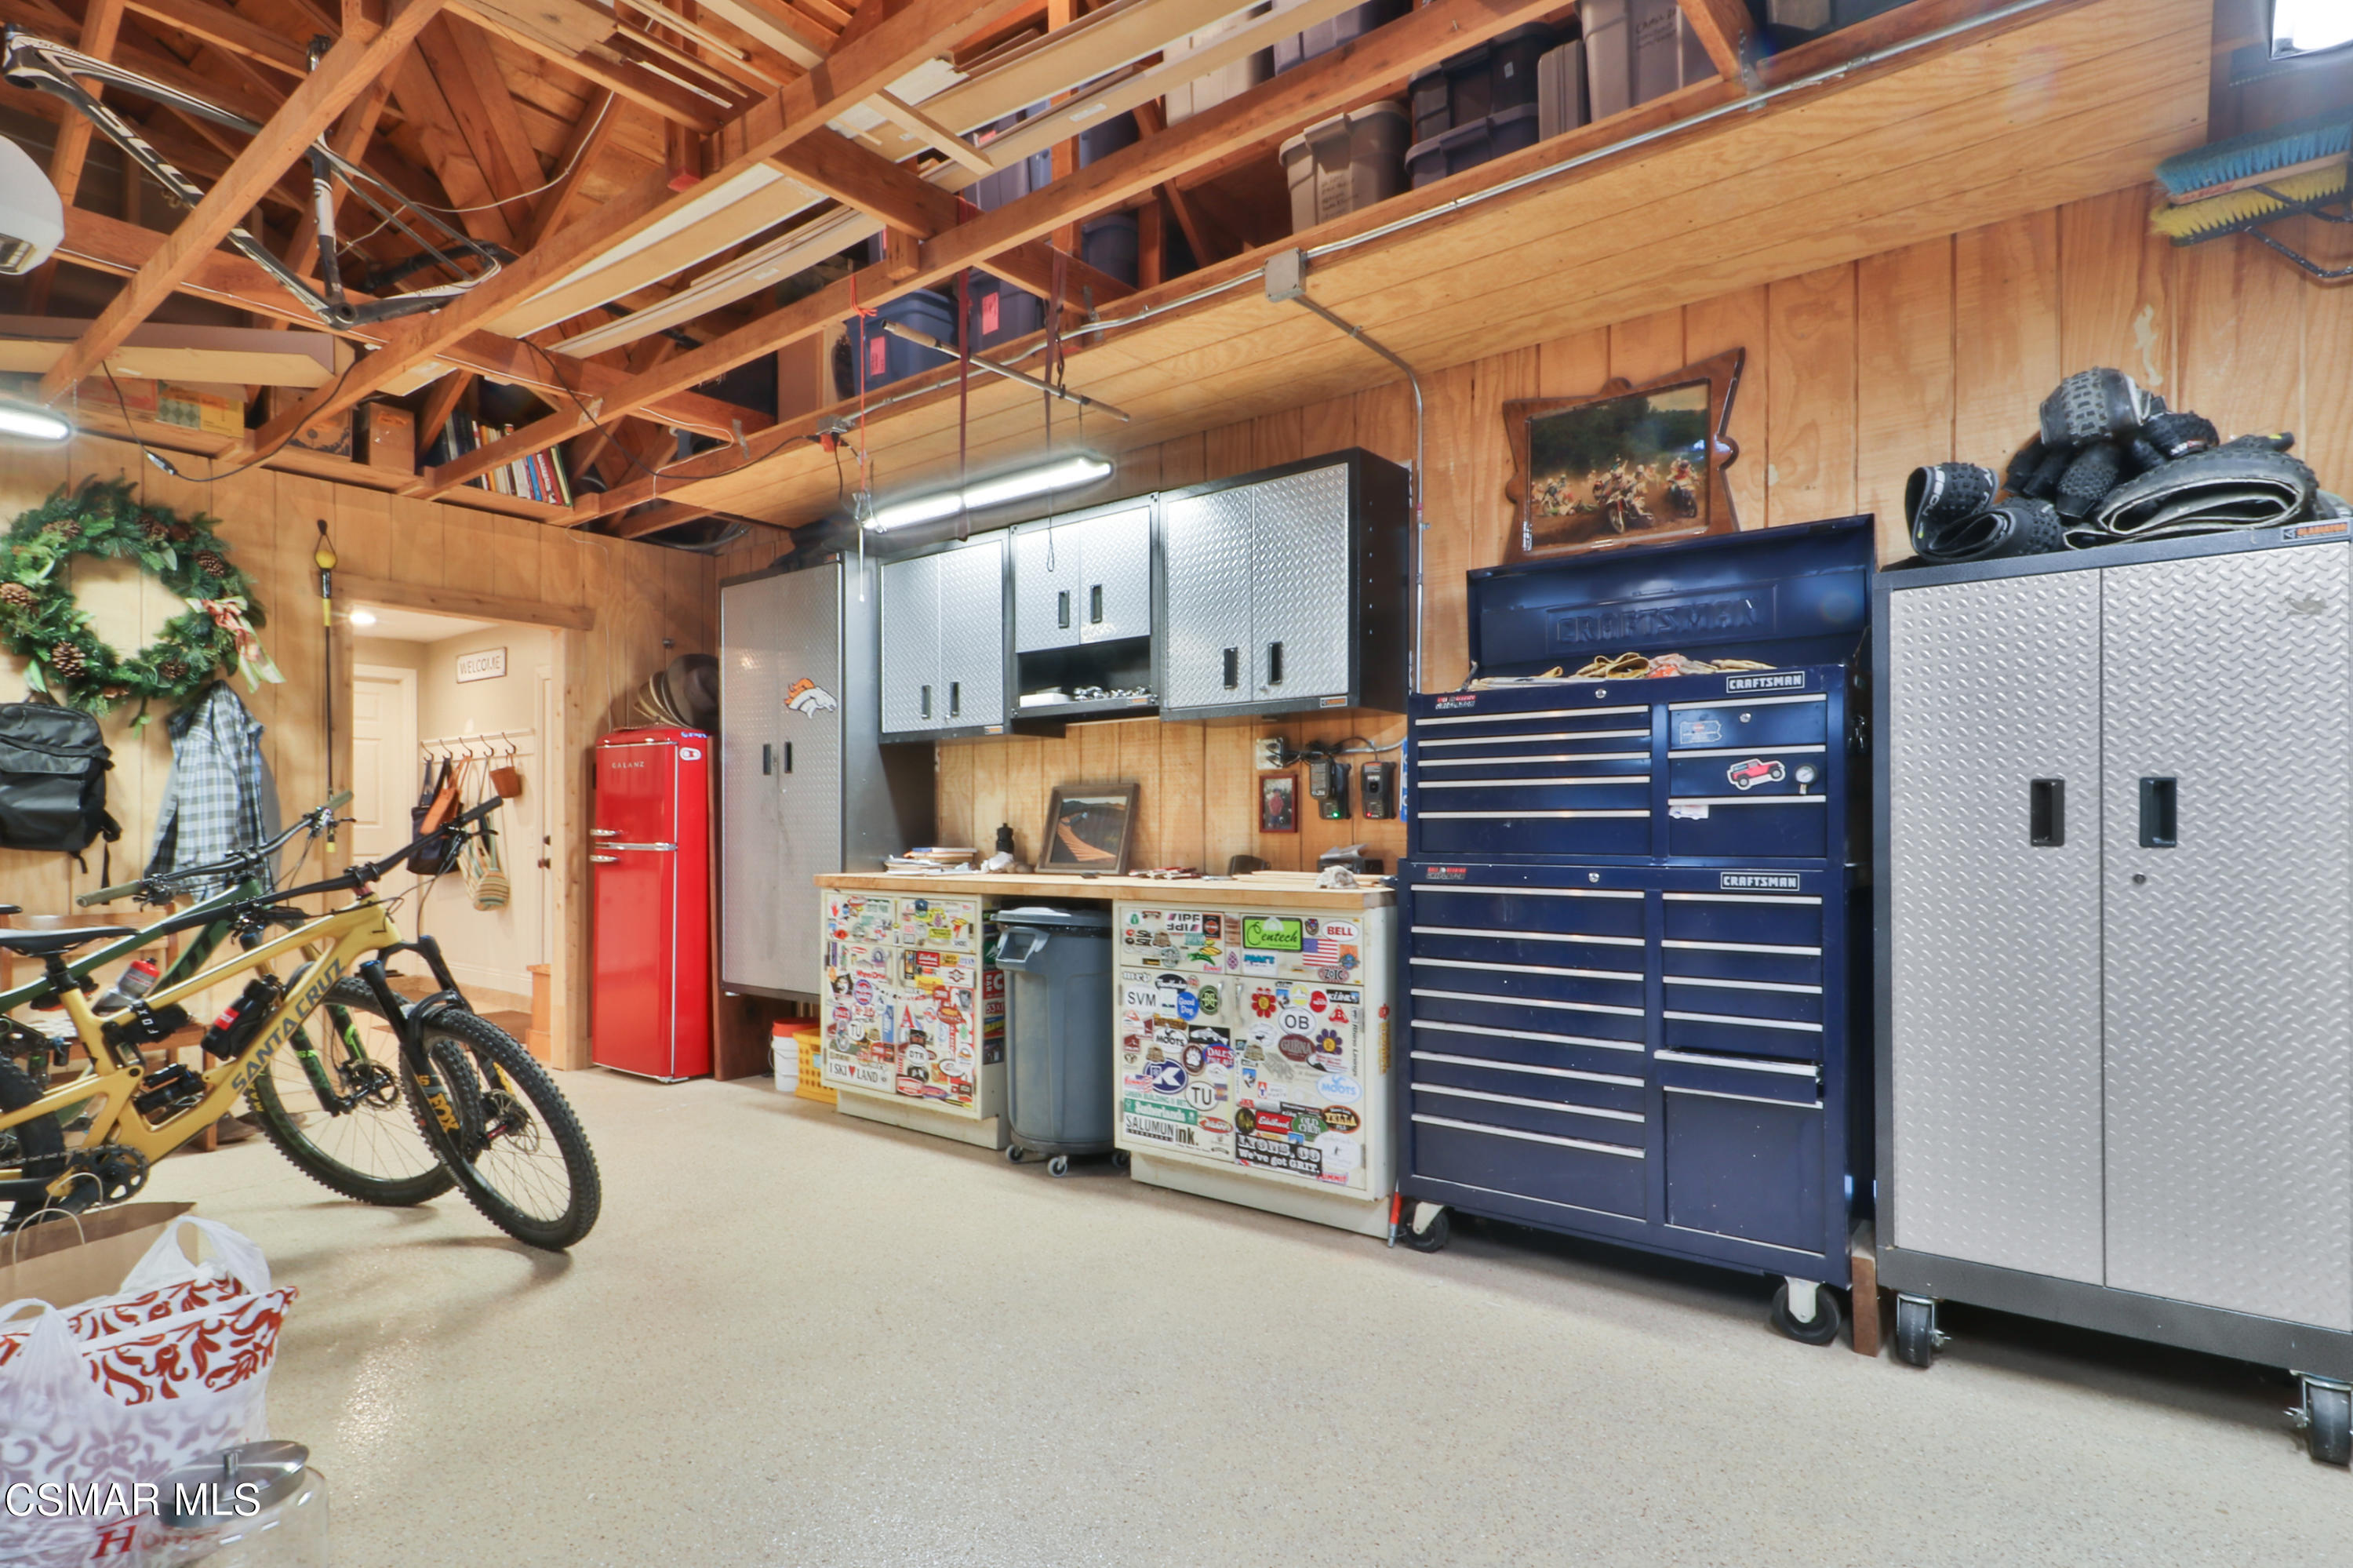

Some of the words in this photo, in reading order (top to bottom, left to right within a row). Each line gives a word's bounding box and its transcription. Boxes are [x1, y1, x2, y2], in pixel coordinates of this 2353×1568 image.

[1557, 596, 1759, 642] CRAFTSMAN
[459, 656, 500, 675] WELCOME
[1729, 675, 1802, 690] CRAFTSMAN
[1723, 875, 1797, 888] CRAFTSMAN
[1246, 920, 1298, 946] Centech
[1326, 926, 1355, 936] BELL
[1127, 991, 1157, 1007] SVM
[136, 1008, 159, 1035] FOX
[231, 1017, 300, 1094] SANTA
[294, 957, 347, 1020] CRUZ
[1285, 1014, 1309, 1030] OB
[850, 1023, 861, 1037] TU
[1156, 1035, 1185, 1047] MOOTS
[835, 1064, 847, 1076] SKI
[857, 1068, 878, 1083] LAND
[1191, 1086, 1213, 1106] TU
[1322, 1083, 1356, 1096] MOOTS
[427, 1092, 461, 1133] FOX
[1324, 1112, 1357, 1126] YELLA
[1258, 1115, 1290, 1130] Edelbrock
[1238, 1148, 1269, 1163] We've
[1270, 1156, 1288, 1167] got
[1289, 1159, 1321, 1174] GRIT.
